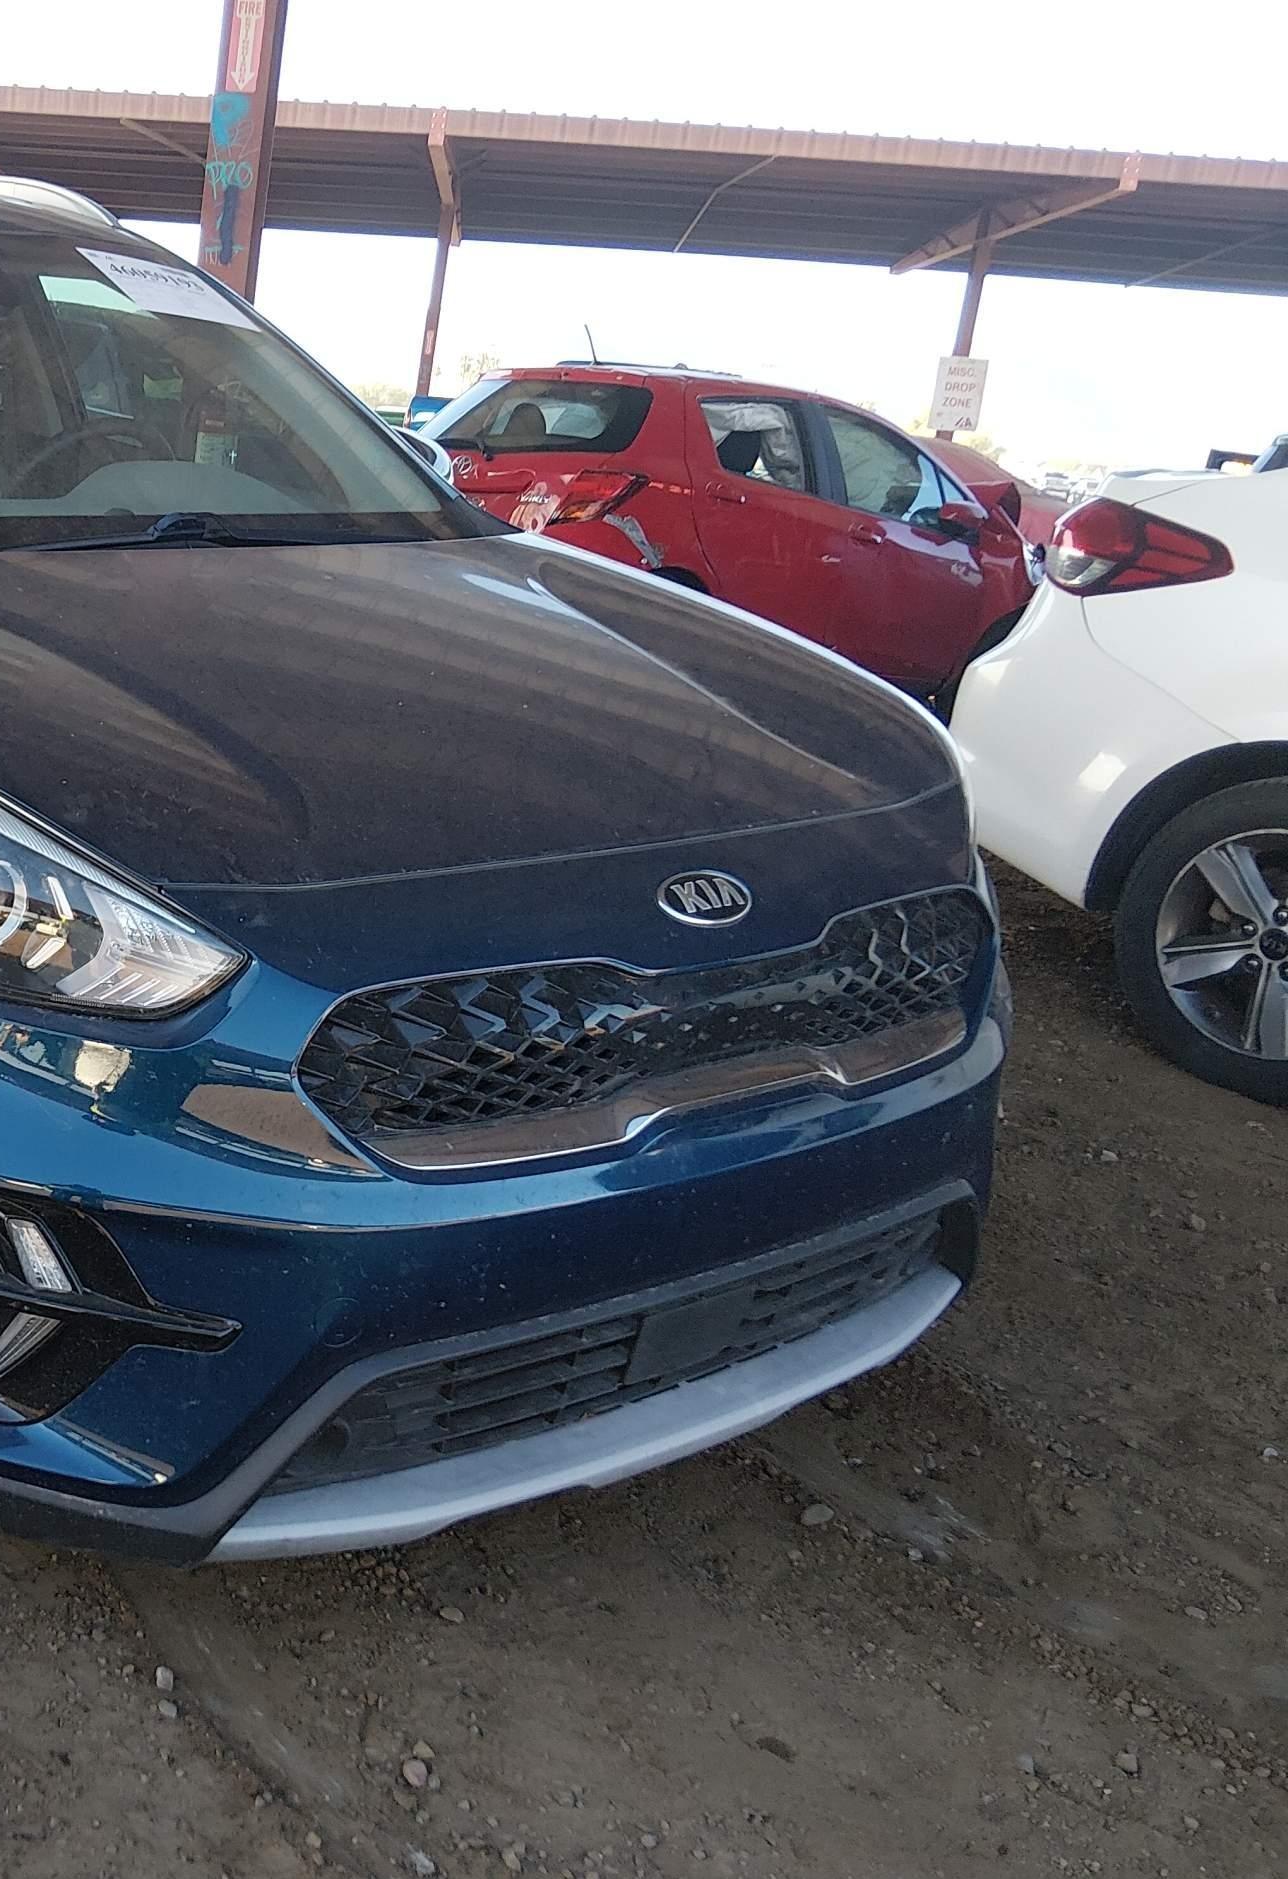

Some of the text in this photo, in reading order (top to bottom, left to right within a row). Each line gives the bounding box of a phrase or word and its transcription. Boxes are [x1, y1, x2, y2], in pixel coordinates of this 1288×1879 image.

[238, 0, 263, 16] FIRE
[947, 366, 977, 378] MISC.
[944, 382, 977, 392] DROP
[941, 396, 974, 408] ZONE
[670, 878, 746, 914] KIA
